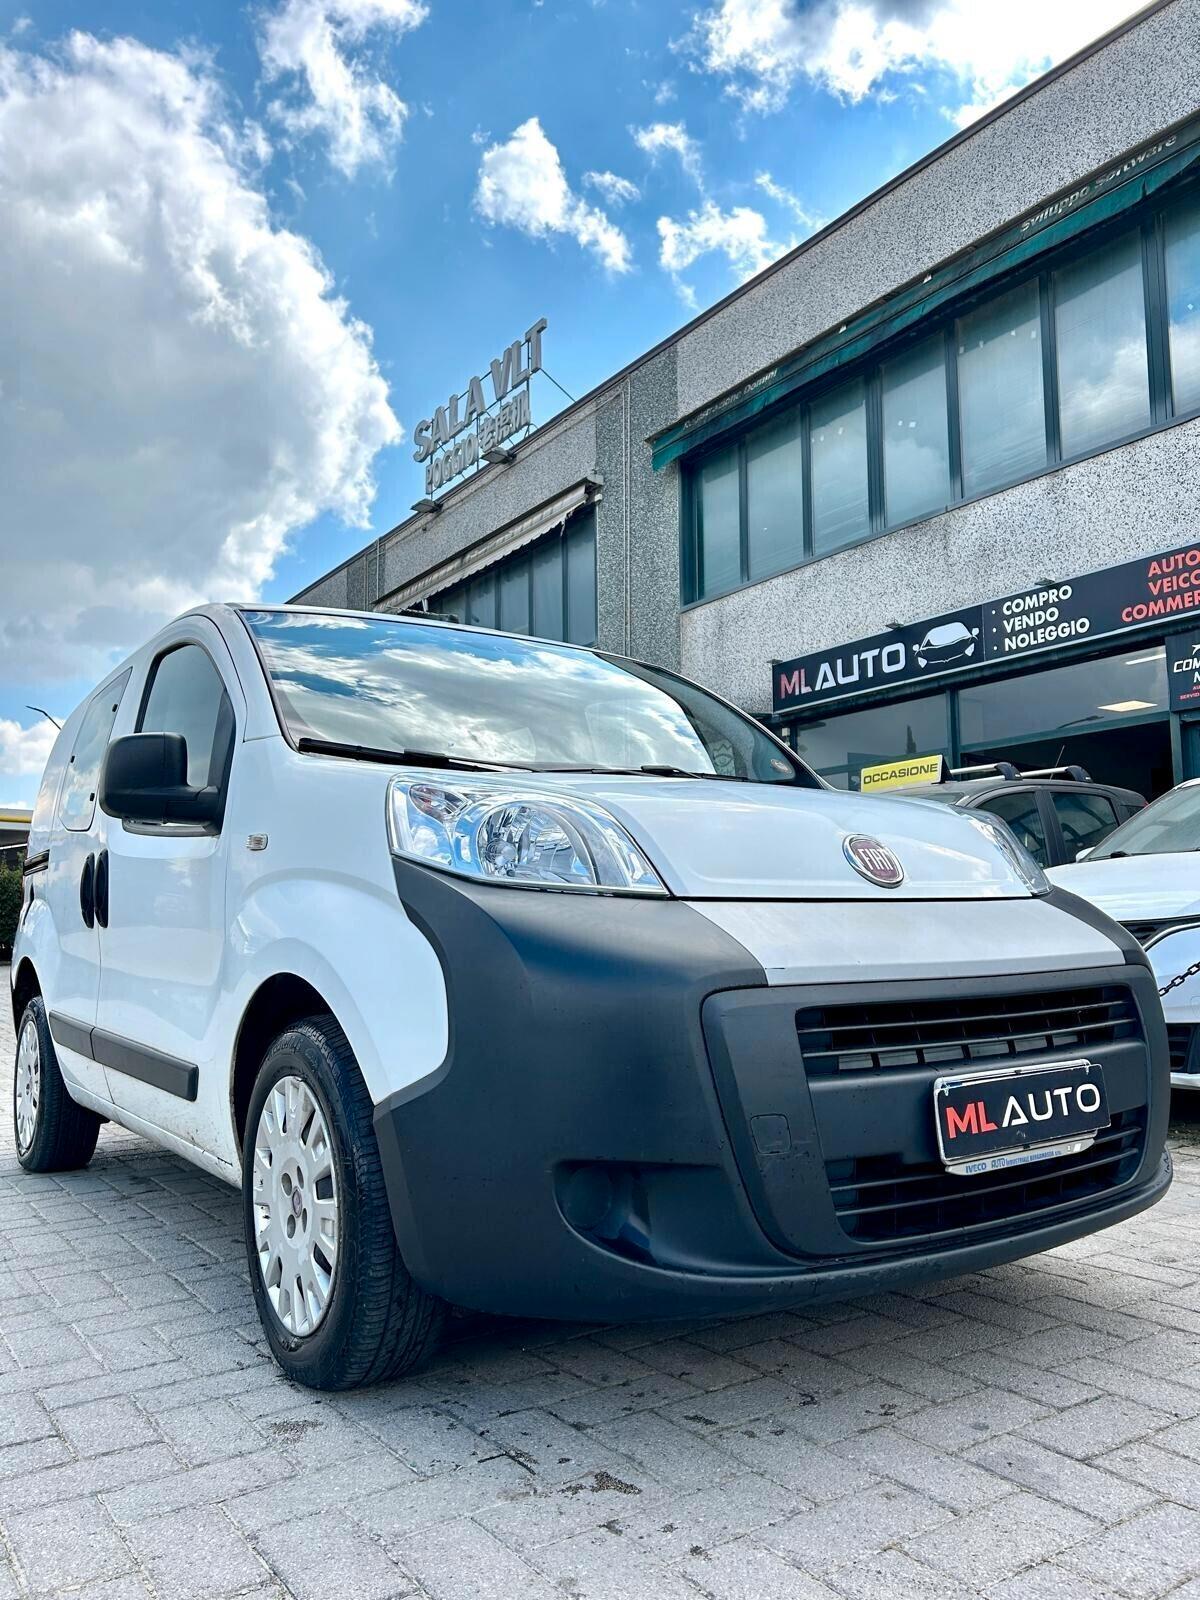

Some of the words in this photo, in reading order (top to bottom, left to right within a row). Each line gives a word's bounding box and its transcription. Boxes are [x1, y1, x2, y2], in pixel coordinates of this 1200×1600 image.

[1020, 186, 1090, 232] Sviluppo
[413, 376, 486, 463] SALA
[490, 317, 548, 401] VLT
[425, 433, 478, 495] POGGIO
[1002, 584, 1073, 615] COMPRO
[1002, 607, 1059, 633] VENDO
[1004, 617, 1090, 651] NOLEGGIO
[780, 668, 812, 699] ML
[814, 642, 906, 691] AUTO
[863, 763, 938, 785] OCCASIONE
[857, 848, 893, 870] FIAT
[945, 1101, 998, 1139] ML
[1002, 1083, 1100, 1128] AUTO
[965, 1162, 987, 1174] IVECO
